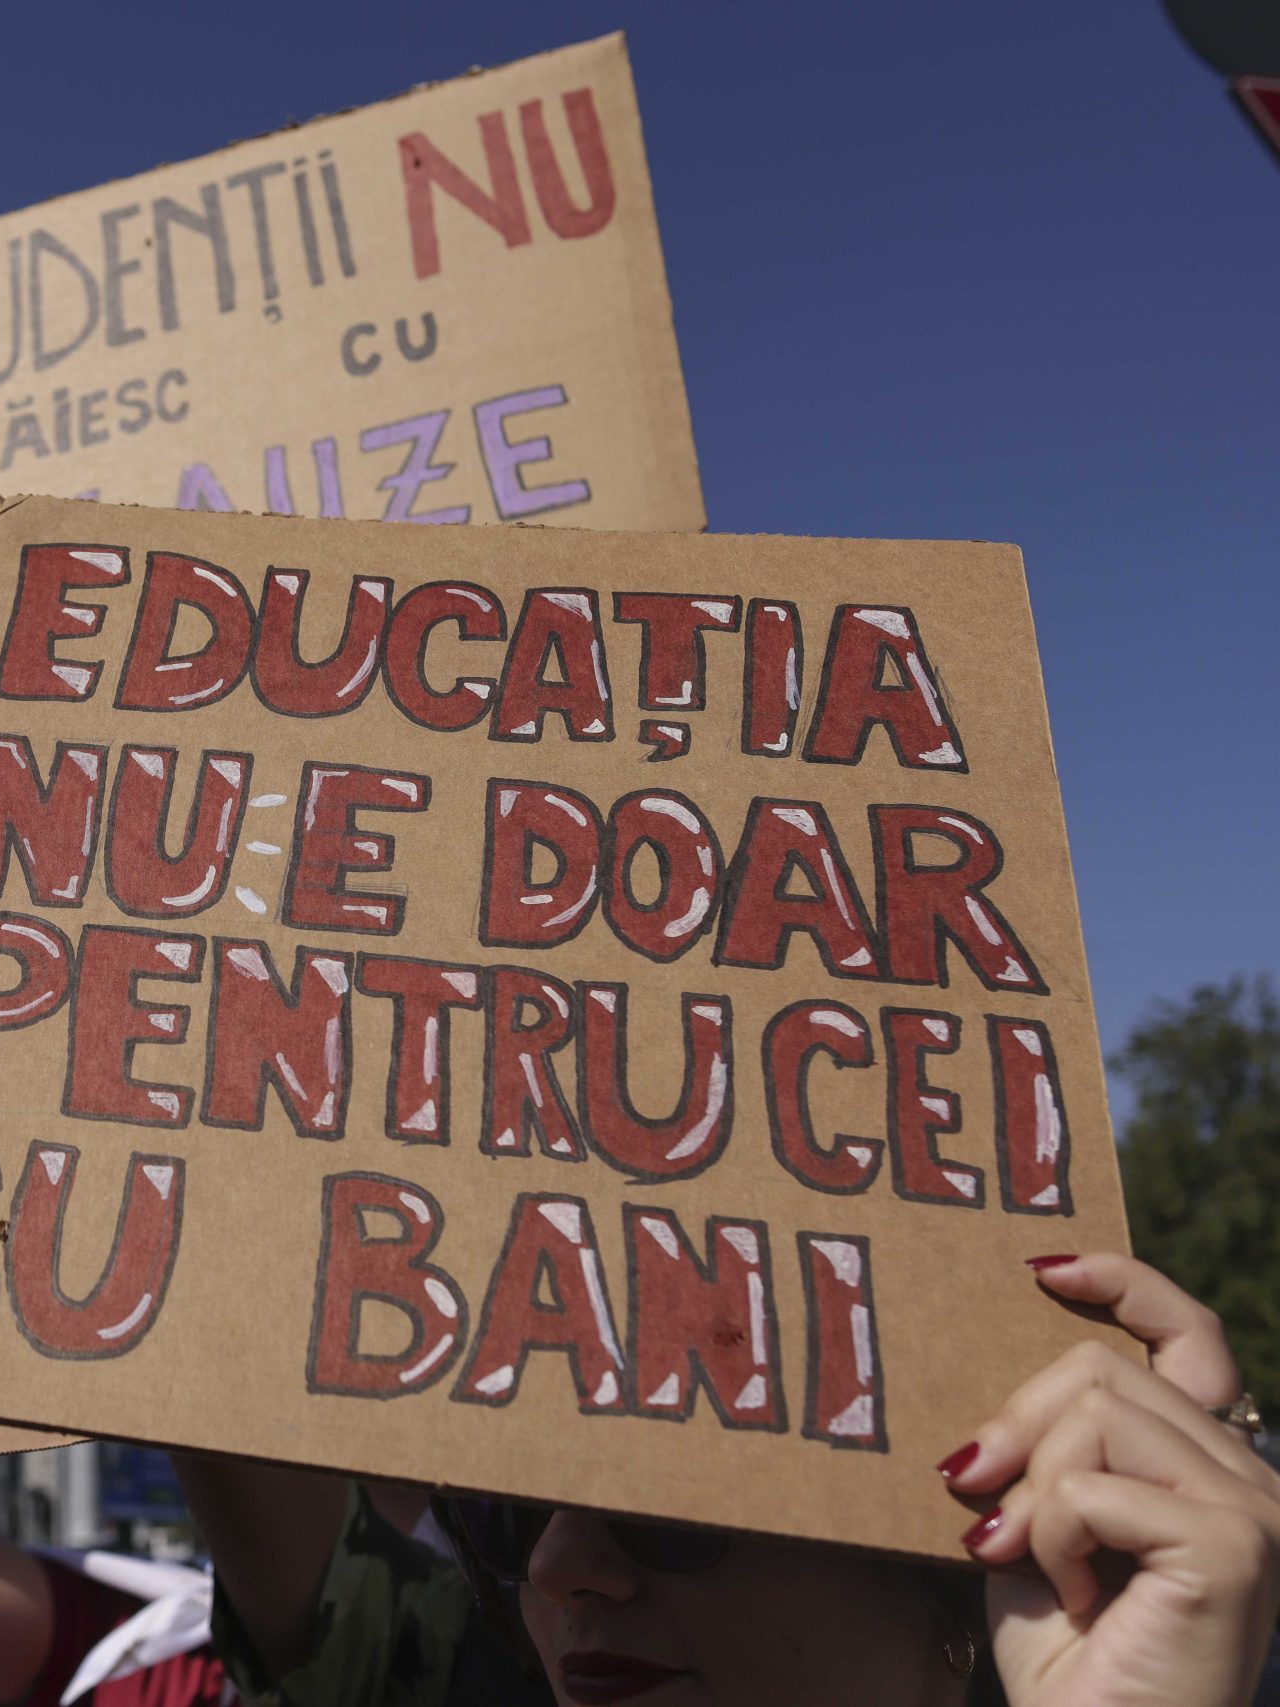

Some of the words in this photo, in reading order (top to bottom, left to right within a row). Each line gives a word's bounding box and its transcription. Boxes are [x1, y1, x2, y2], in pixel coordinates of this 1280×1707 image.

[398, 87, 619, 280] NU
[342, 311, 439, 377] CU
[282, 761, 432, 935] E
[479, 772, 1052, 995] DOAR
[760, 999, 1075, 1216] CEI
[305, 1170, 889, 1454] BANI
